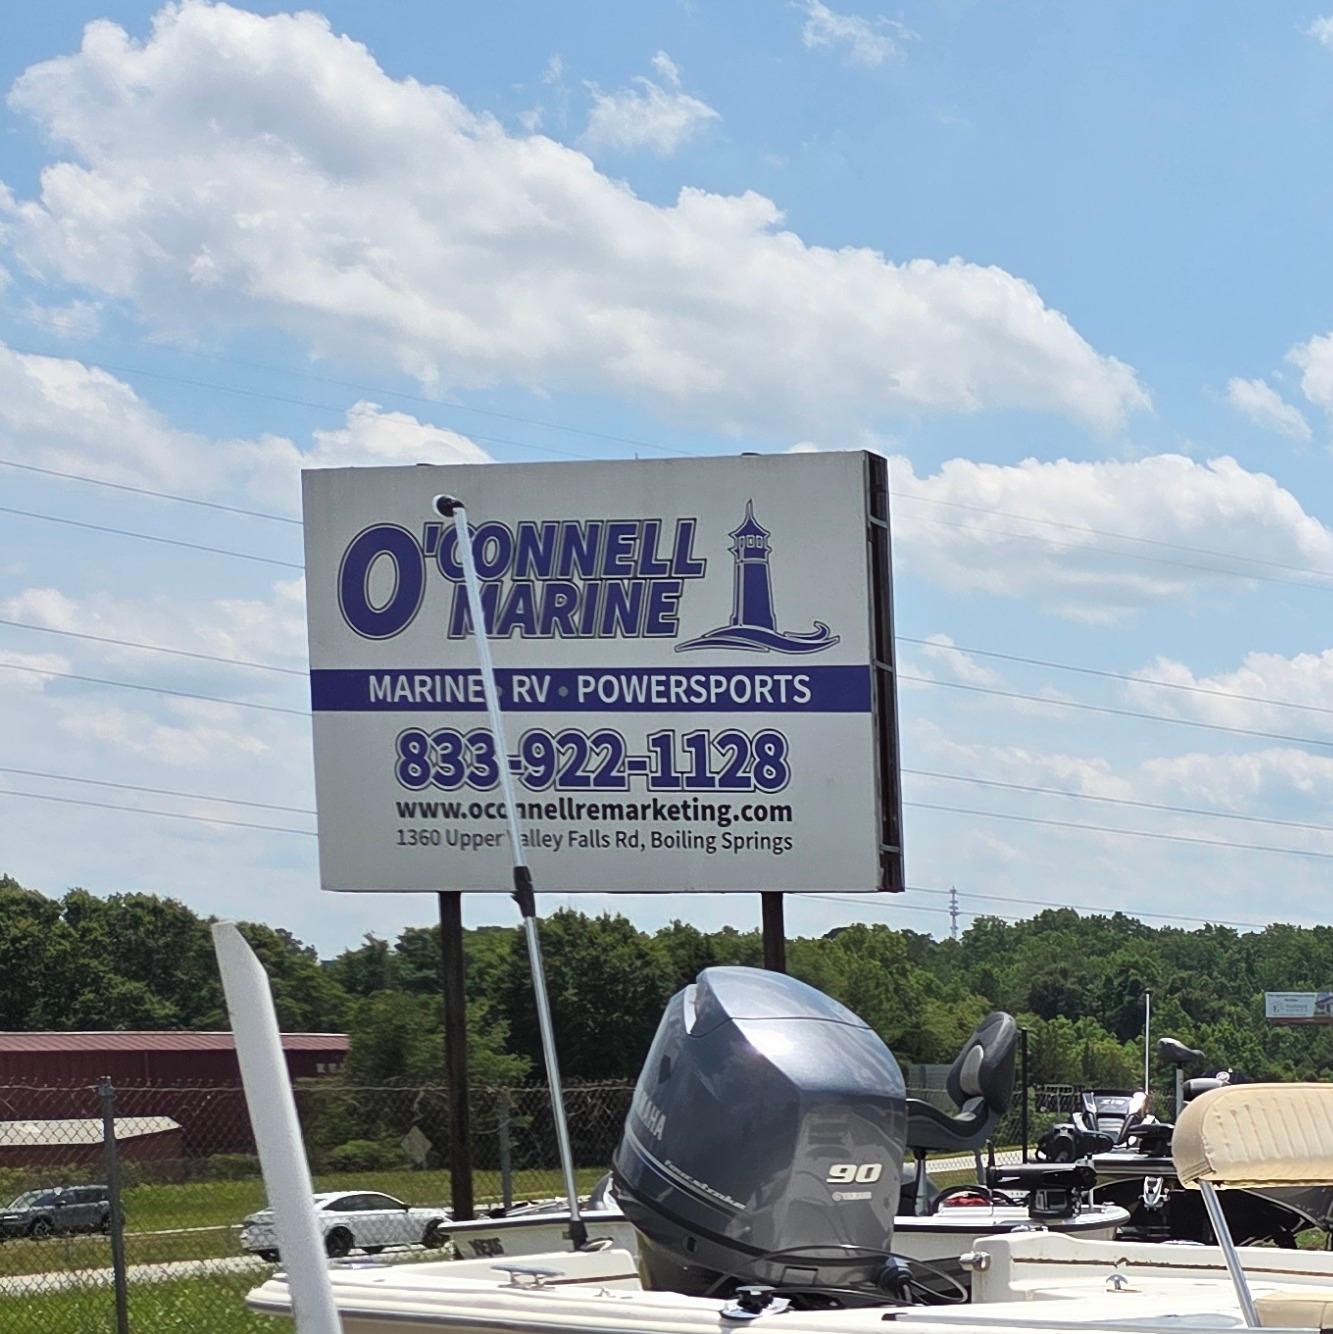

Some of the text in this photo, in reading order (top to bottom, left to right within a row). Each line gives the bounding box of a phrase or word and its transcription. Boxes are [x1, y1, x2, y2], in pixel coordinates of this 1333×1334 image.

[337, 517, 707, 640] O'CONNELL
[447, 578, 681, 639] MARINE
[368, 674, 812, 704] MARINE RV POWERSPORTS
[395, 727, 790, 794] 833-922-1128
[397, 828, 793, 857] 1360 Upper alley Falls Rd, Boiling Springs
[826, 1163, 883, 1184] 90
